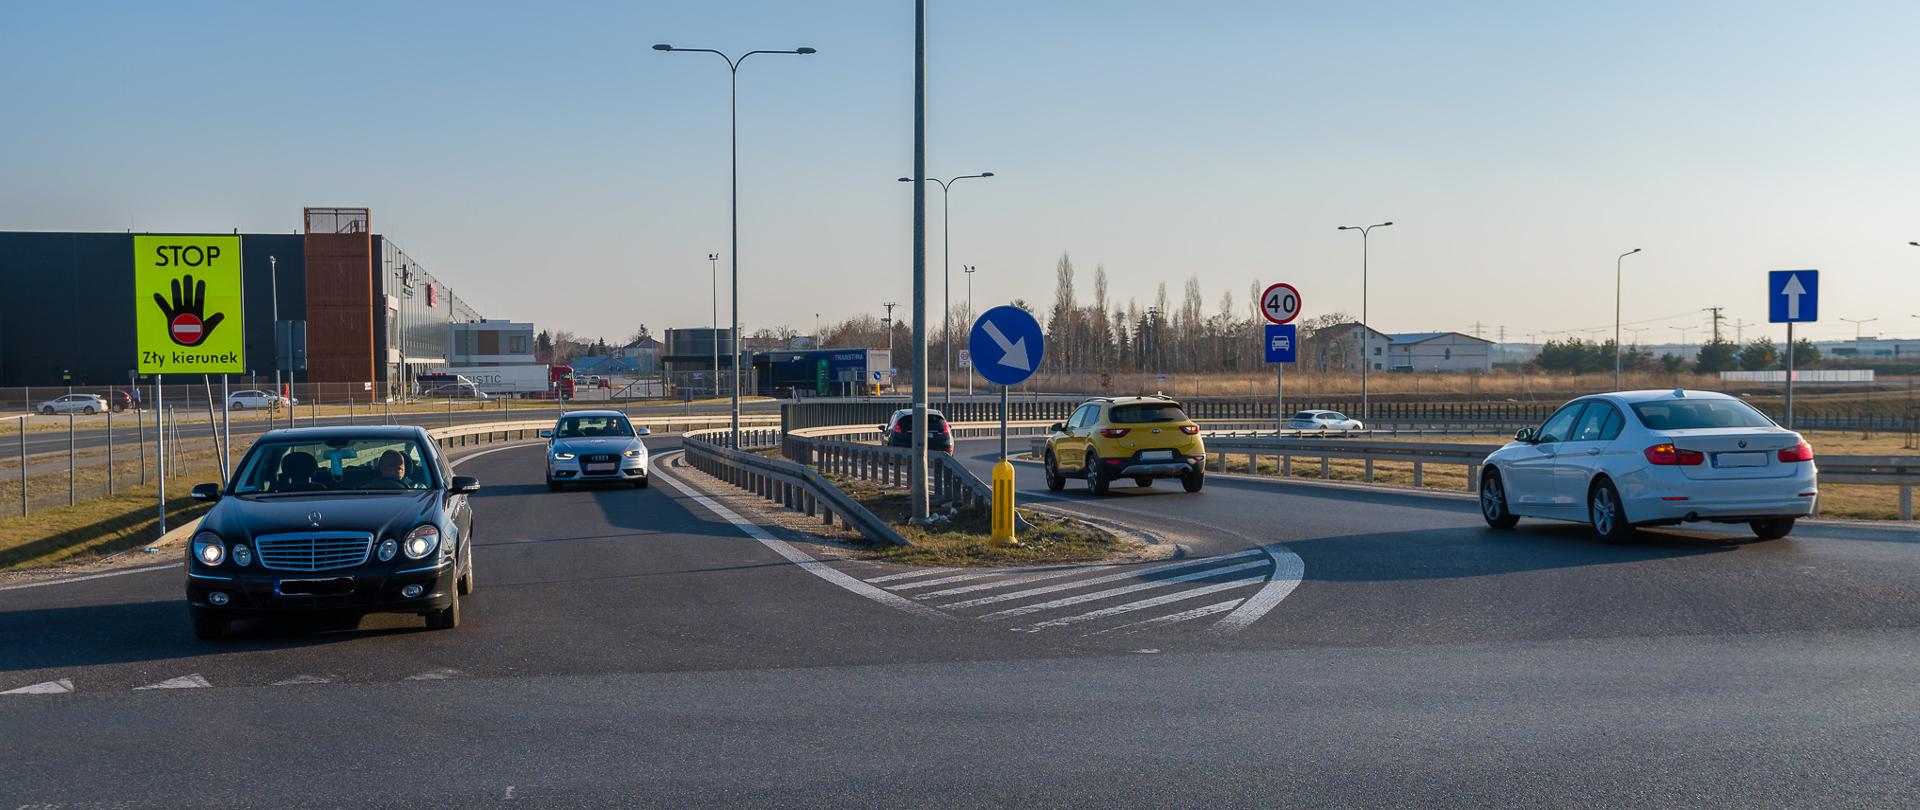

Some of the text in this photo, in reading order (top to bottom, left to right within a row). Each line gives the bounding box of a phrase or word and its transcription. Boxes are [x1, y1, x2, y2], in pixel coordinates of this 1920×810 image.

[155, 245, 221, 267] STOP
[1267, 294, 1296, 313] 40
[143, 351, 238, 367] Zły kierunek
